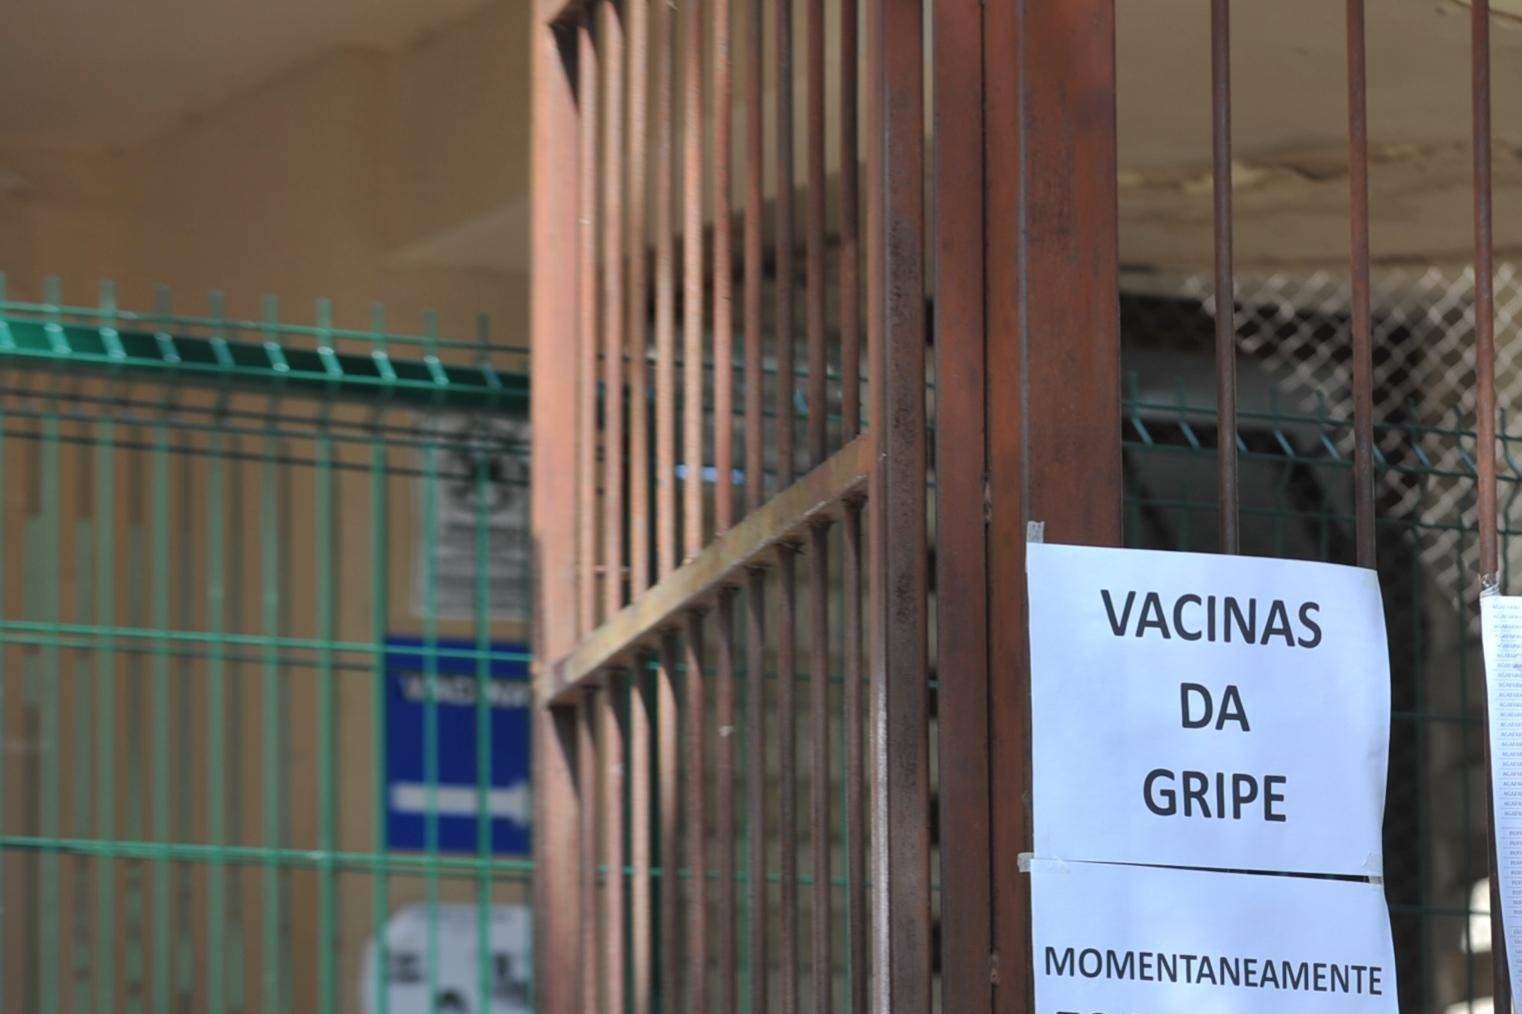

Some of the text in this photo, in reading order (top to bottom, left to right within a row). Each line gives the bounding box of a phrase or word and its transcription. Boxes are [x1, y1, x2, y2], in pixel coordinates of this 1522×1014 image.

[1100, 589, 1322, 649] VACINAS
[1180, 682, 1251, 732] DA
[1143, 768, 1287, 823] GRIPE
[1045, 946, 1383, 996] MOMENTANEAMENTE
